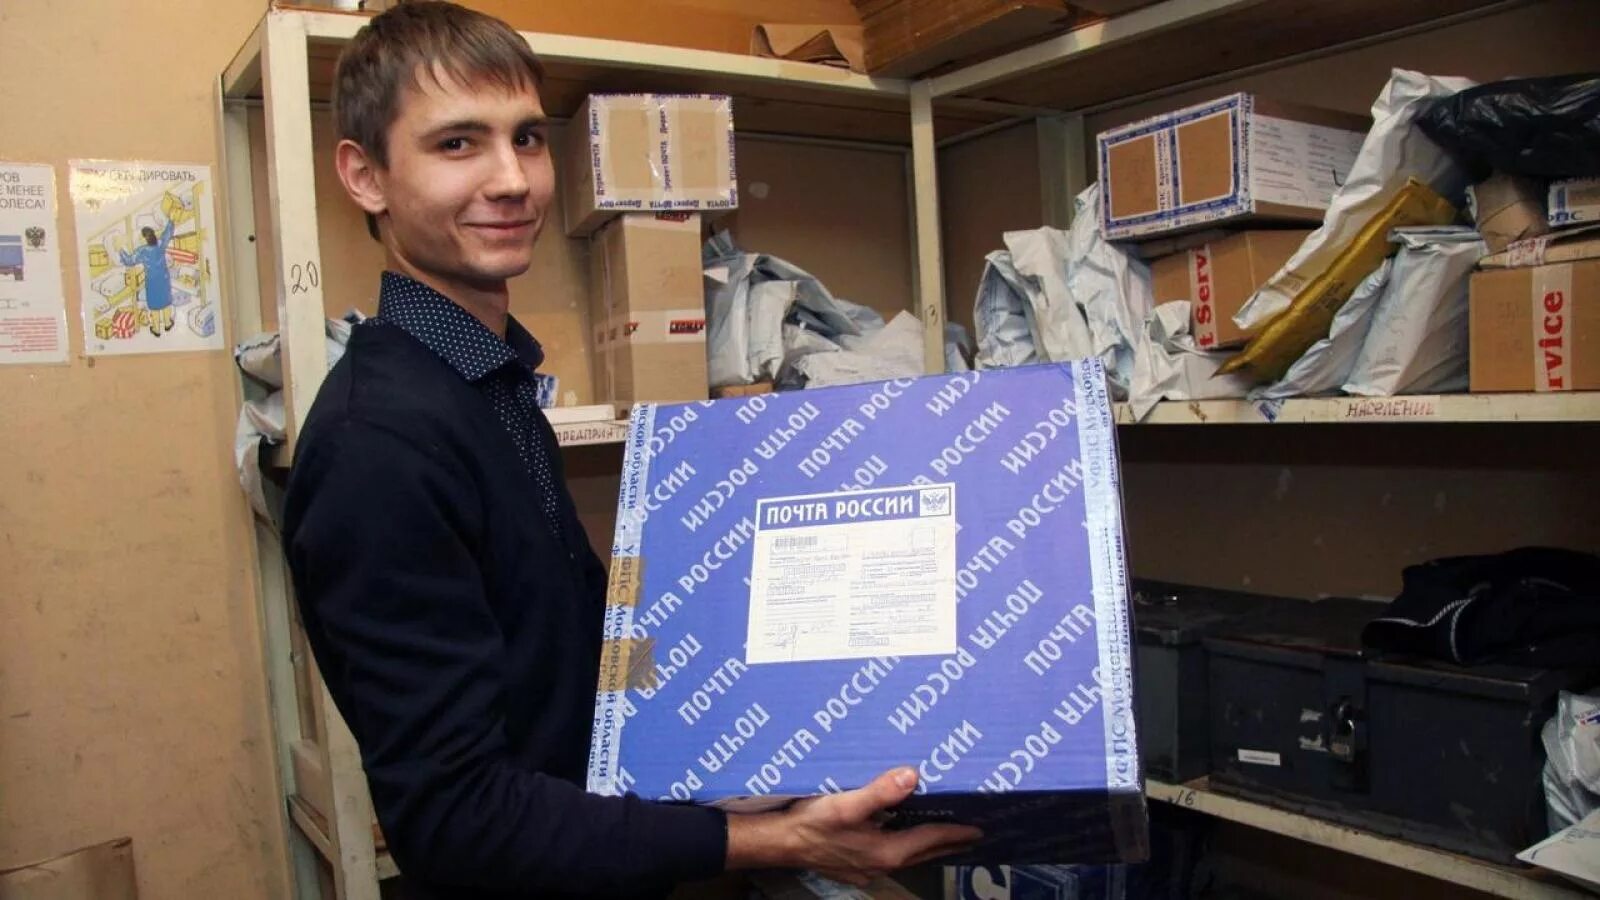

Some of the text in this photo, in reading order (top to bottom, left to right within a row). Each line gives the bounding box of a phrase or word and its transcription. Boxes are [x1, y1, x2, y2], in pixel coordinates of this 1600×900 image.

[6, 184, 45, 196] МЕНЕЕ
[290, 260, 319, 295] 20
[1538, 290, 1563, 389] rvice
[798, 376, 919, 479] ПОЧТА РОСС
[930, 400, 1011, 477] РОССИИ
[1000, 397, 1078, 475] РОССИИ
[631, 460, 697, 523] ОССИИ
[680, 401, 821, 533] ПОЧТА РОССИИ
[1006, 458, 1085, 539] РОССИИ
[766, 494, 914, 525] ПОЧТА РОССИИ
[631, 516, 757, 642] ОЧТА РОССИИ
[968, 579, 1044, 650] ПОЧТА
[634, 633, 703, 700] ПОЧТА
[1024, 604, 1097, 677] ПОЧТА
[677, 657, 749, 726] ПОЧТА
[887, 646, 977, 736] РОССИИ
[1053, 665, 1104, 726] ОЧТА
[598, 708, 615, 778] области
[697, 702, 771, 774] ПОЧТА
[744, 727, 821, 796] ПОЧТА
